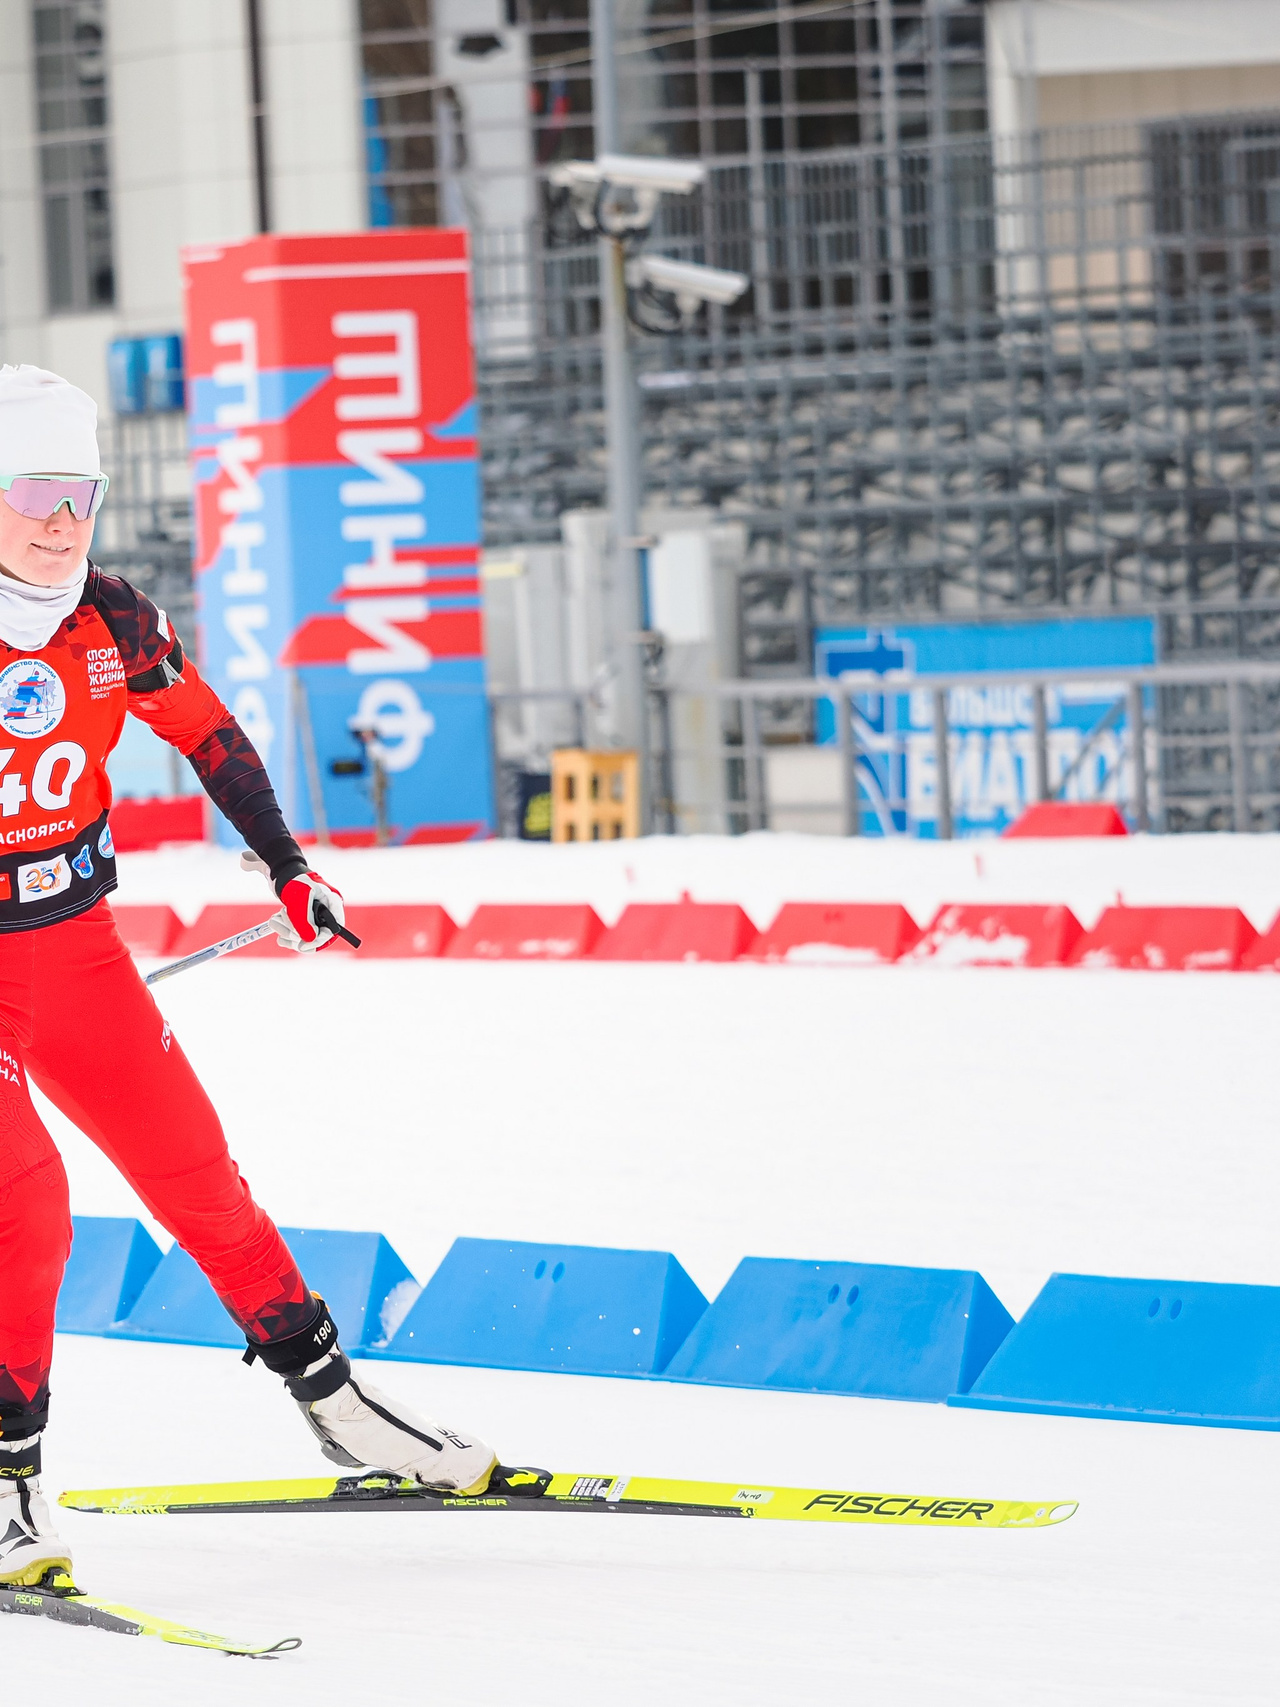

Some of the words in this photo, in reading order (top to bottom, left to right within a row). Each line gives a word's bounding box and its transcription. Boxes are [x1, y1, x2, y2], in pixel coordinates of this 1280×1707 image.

[329, 309, 434, 773] ФИНИШ
[33, 660, 57, 680] РОССИИ
[88, 670, 126, 687] ЖИЗНИ
[312, 1318, 332, 1347] 190
[443, 1498, 508, 1507] FISCHER
[801, 1493, 995, 1521] FISCHER
[14, 1593, 43, 1607] FISCHER
